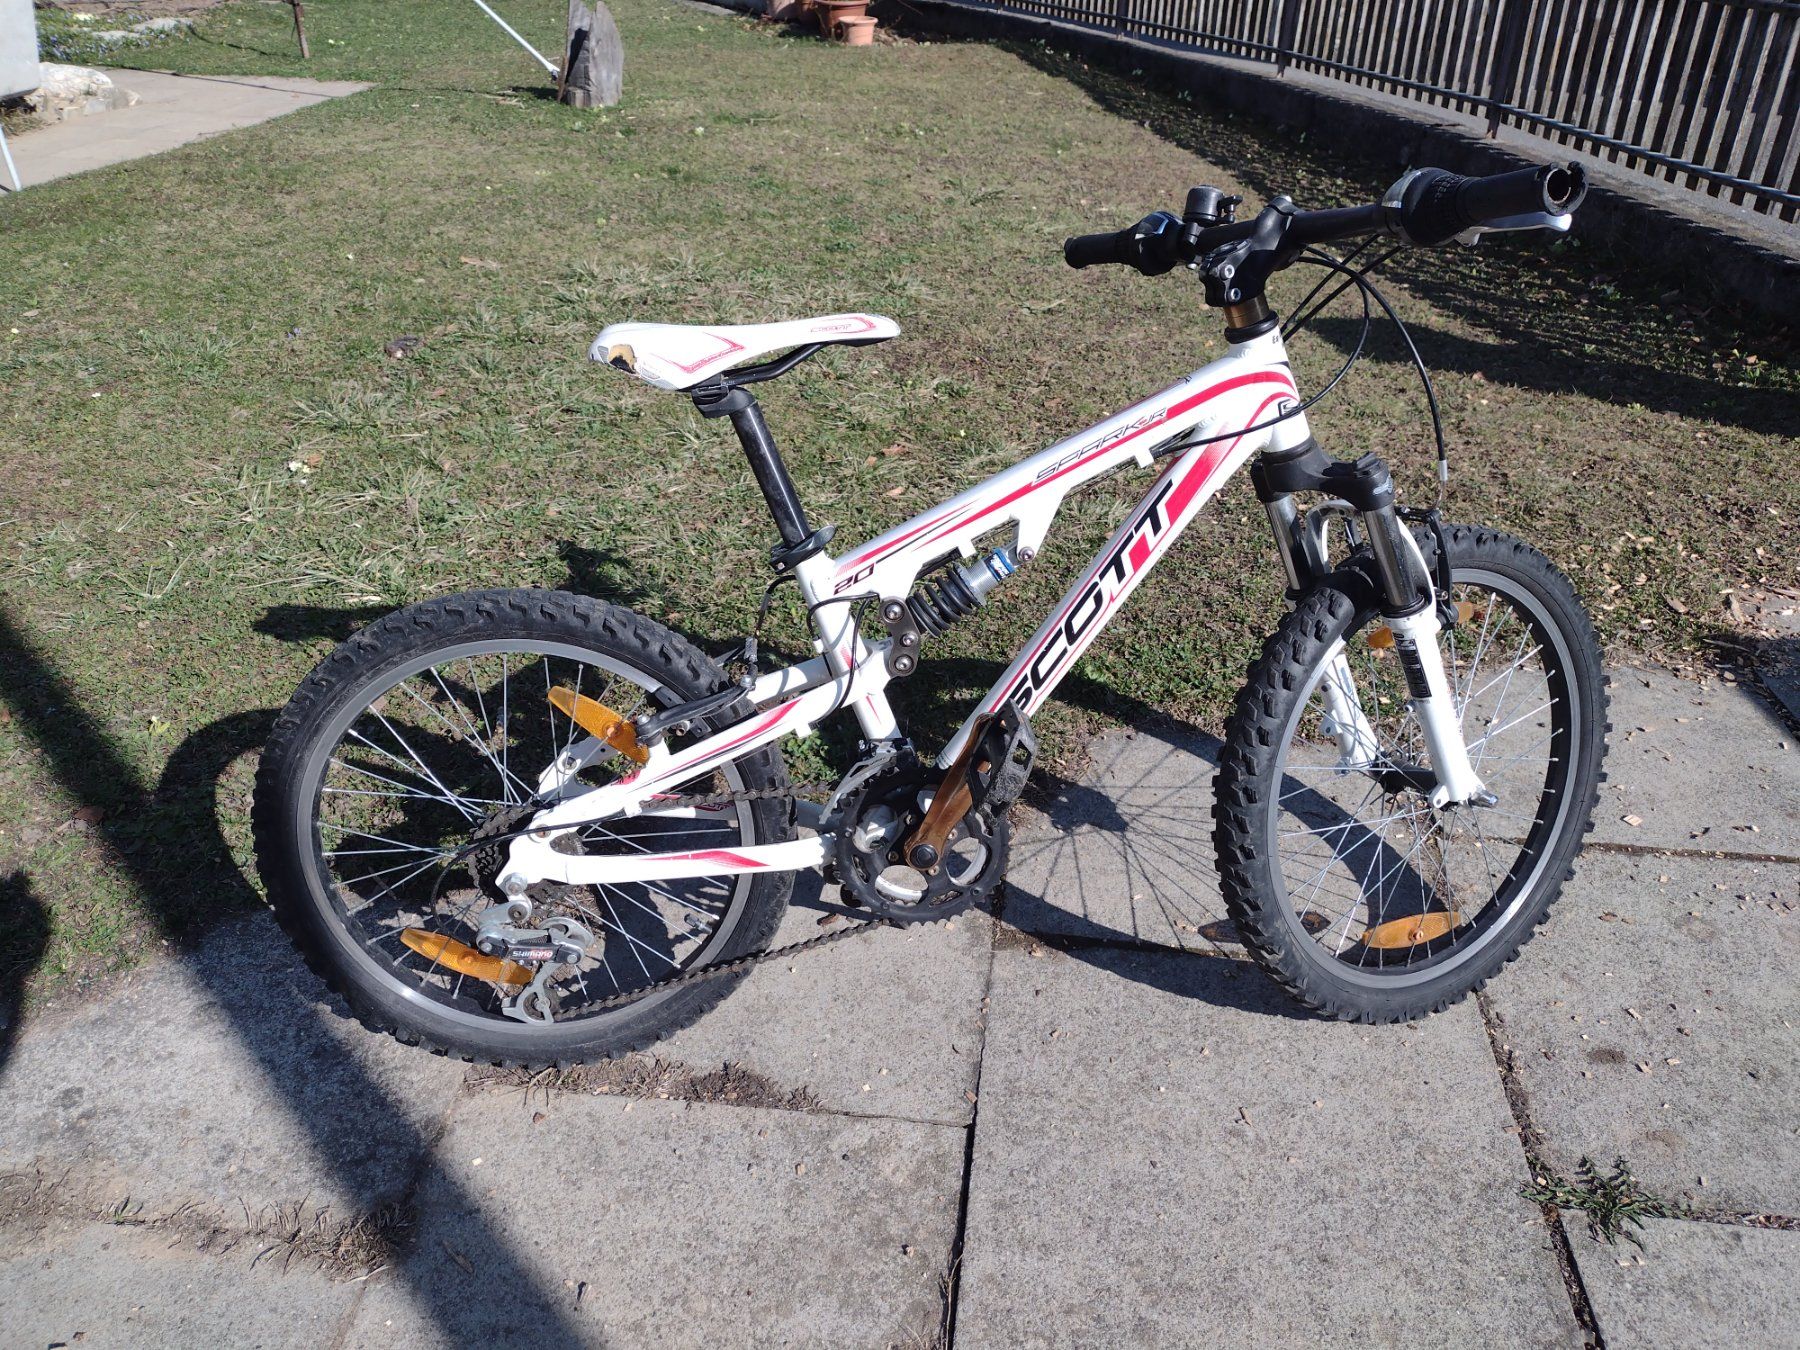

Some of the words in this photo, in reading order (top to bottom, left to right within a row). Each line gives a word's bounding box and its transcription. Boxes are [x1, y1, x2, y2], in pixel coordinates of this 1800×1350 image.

[1036, 416, 1144, 482] SPARK
[833, 562, 875, 596] 20
[1008, 478, 1173, 712] SCOTT
[512, 949, 554, 958] SHIMANO
